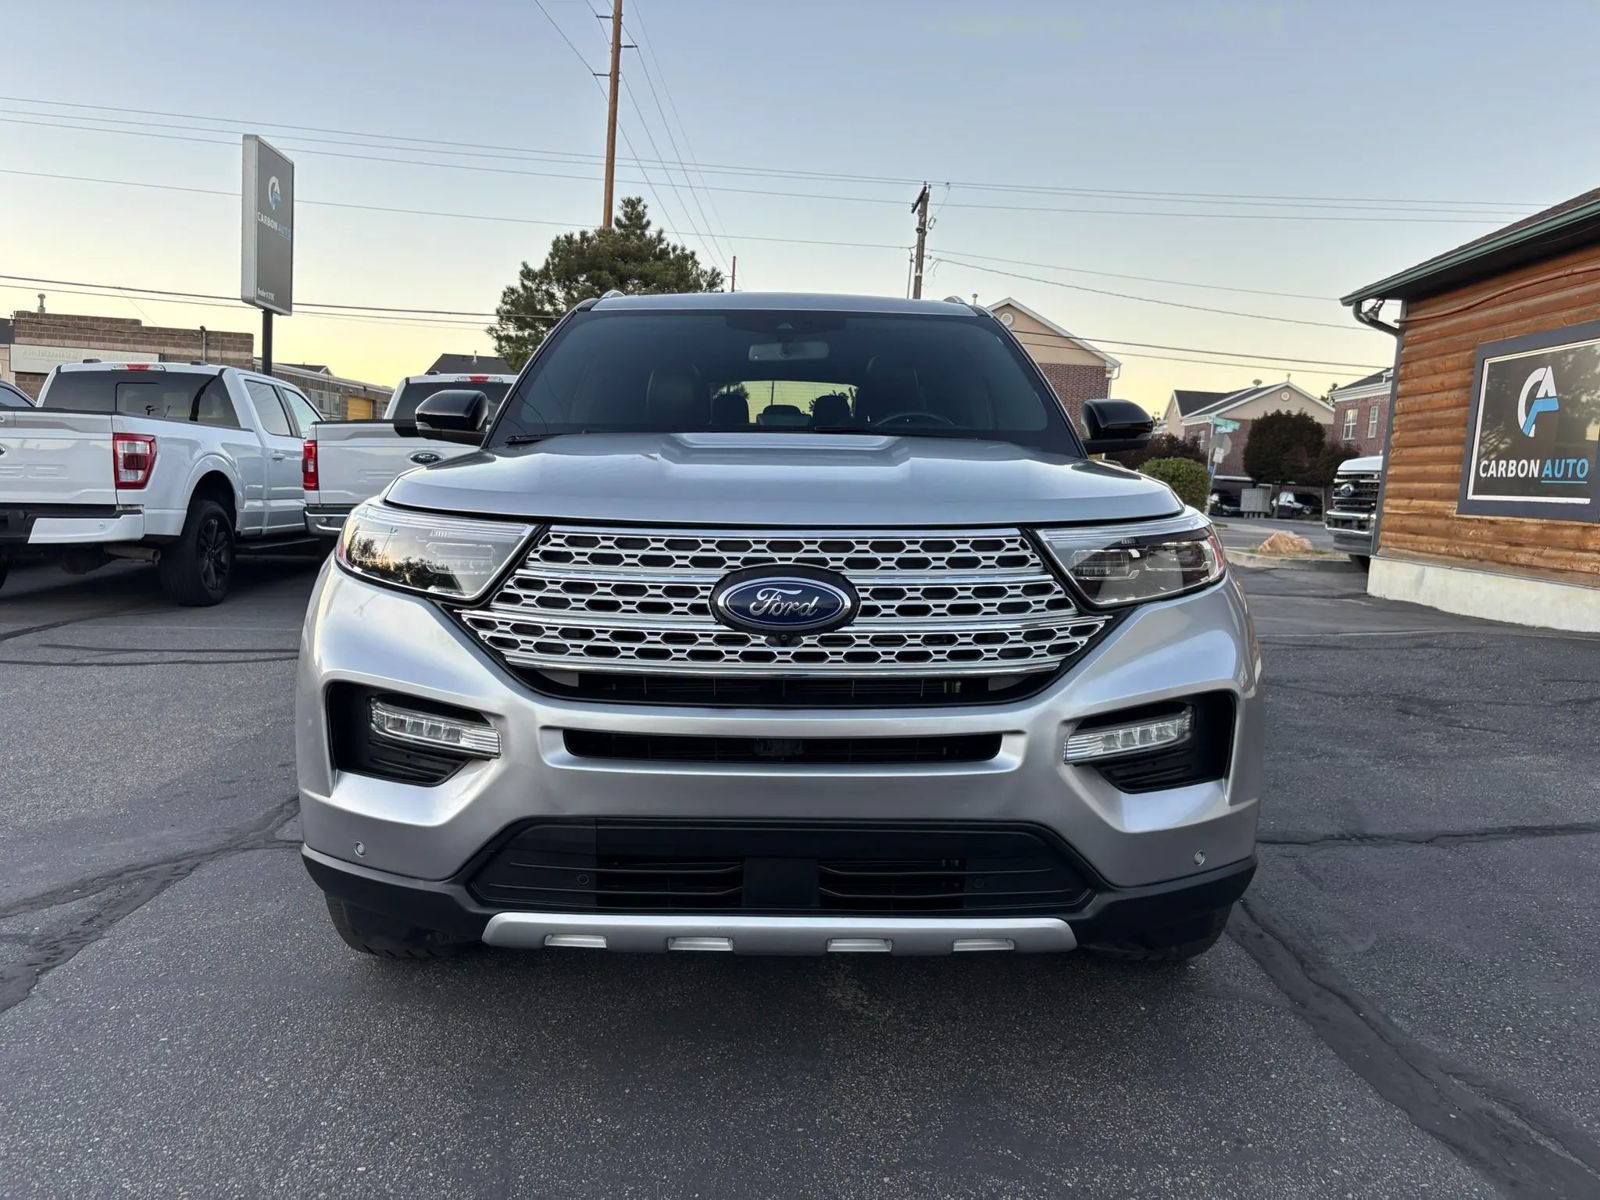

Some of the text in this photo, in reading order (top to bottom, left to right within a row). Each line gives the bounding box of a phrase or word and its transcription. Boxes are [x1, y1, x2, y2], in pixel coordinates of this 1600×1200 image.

[257, 211, 278, 231] CARBON
[1479, 458, 1589, 478] CARBON AUTO
[750, 587, 820, 616] Ford
